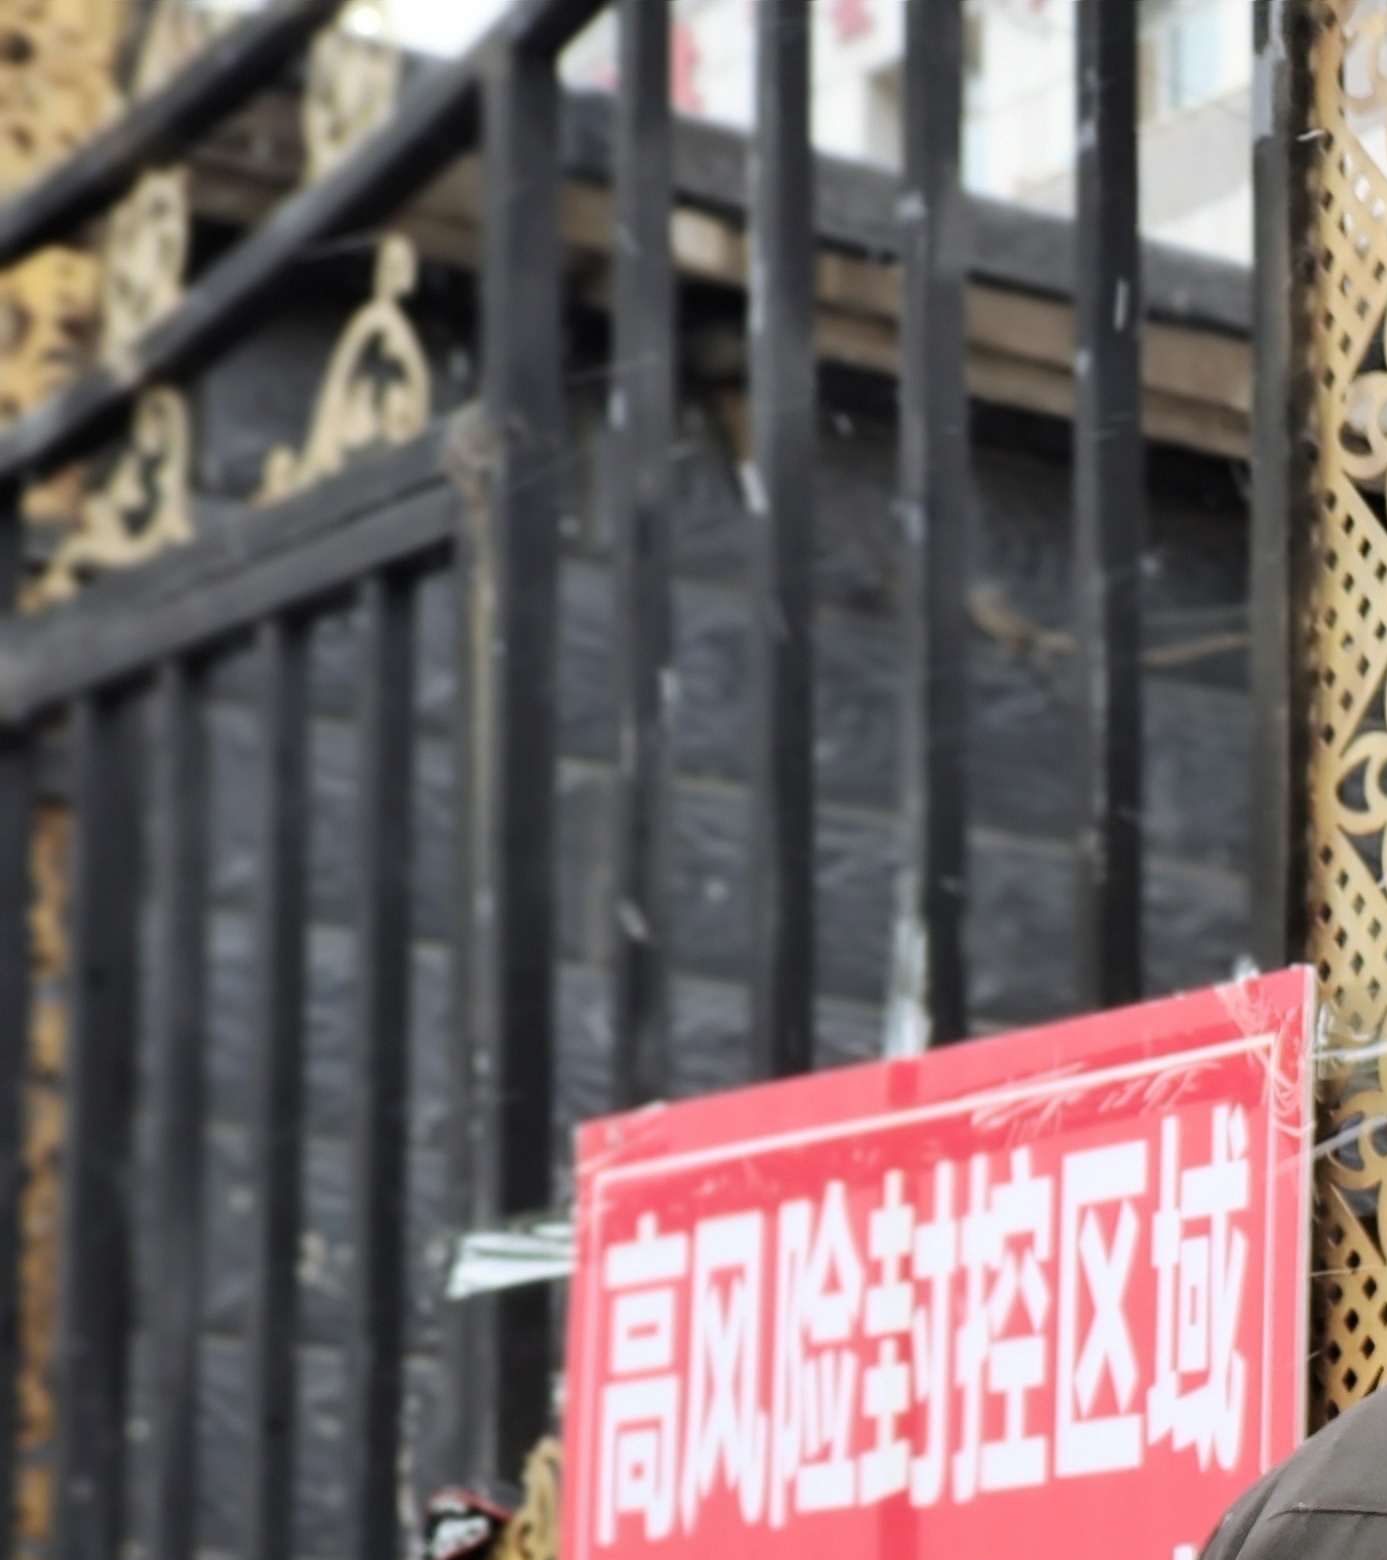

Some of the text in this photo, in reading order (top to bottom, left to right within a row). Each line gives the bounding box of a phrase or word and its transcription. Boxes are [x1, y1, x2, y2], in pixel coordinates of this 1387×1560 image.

[597, 1103, 1250, 1545] 高风险封控区域
